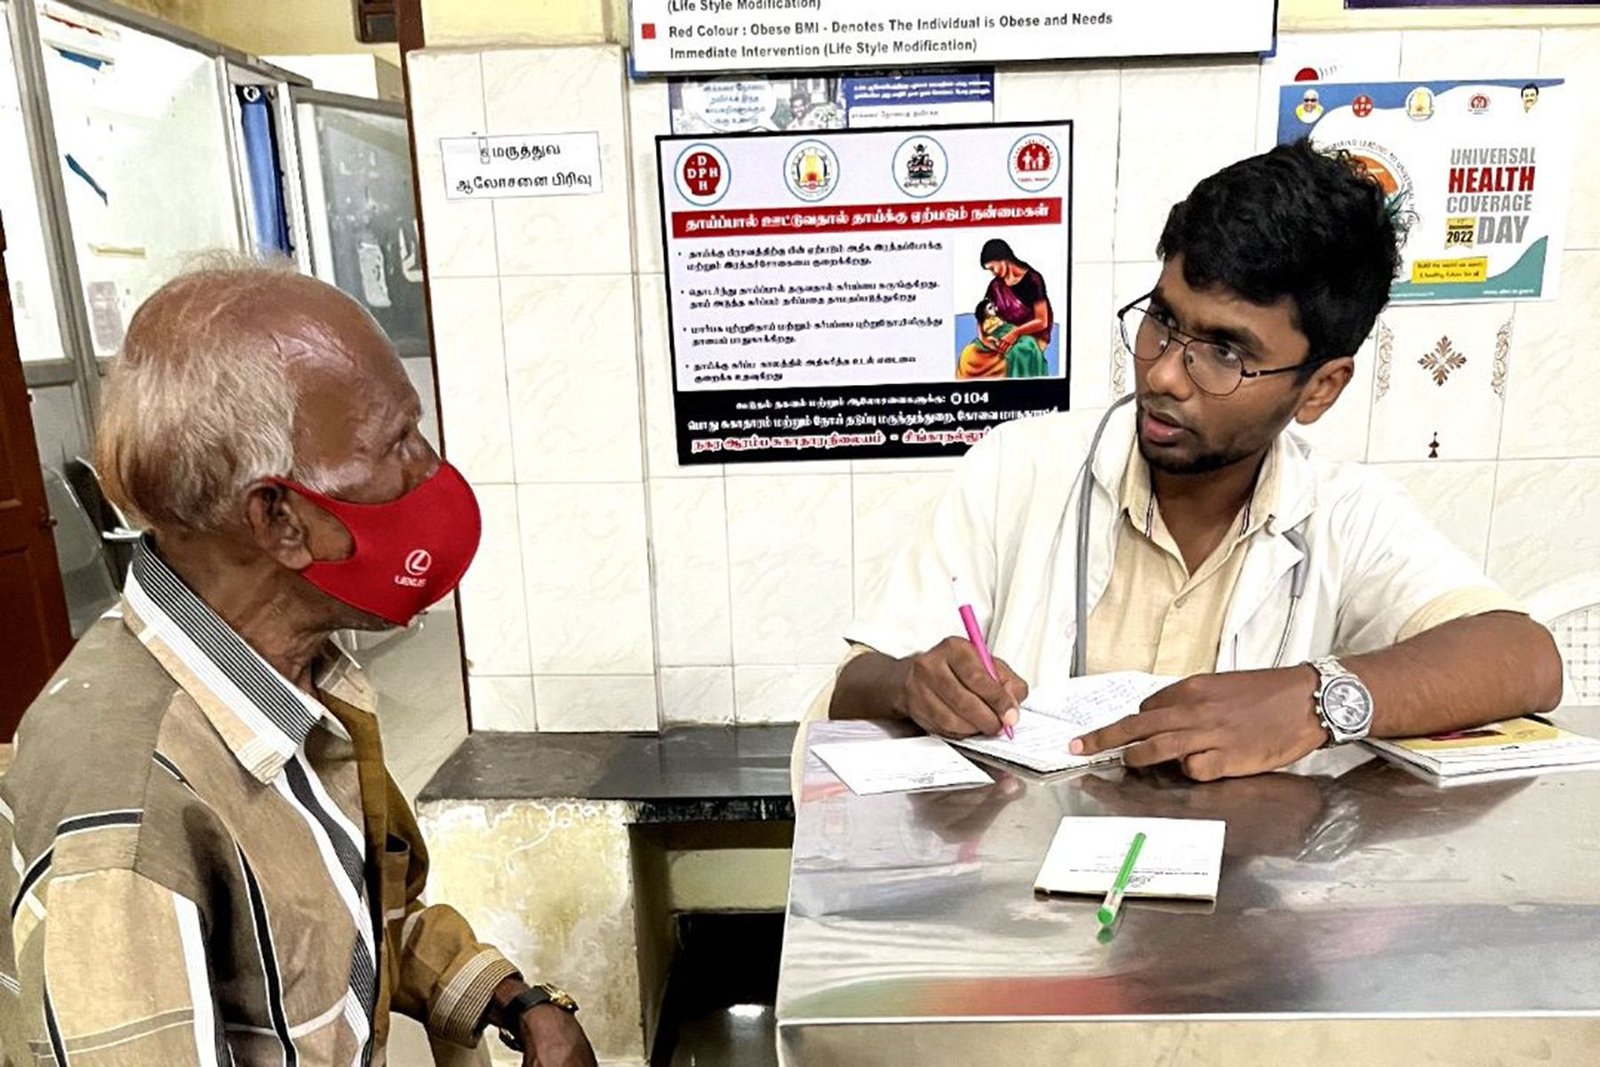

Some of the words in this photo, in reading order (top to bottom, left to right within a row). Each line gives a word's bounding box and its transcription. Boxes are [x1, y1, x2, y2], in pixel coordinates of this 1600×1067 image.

[668, 0, 696, 15] (Life
[700, 0, 733, 14] Style
[737, 0, 821, 11] Modification)
[669, 25, 693, 38] Red
[697, 24, 739, 38] Colour
[751, 23, 791, 36] Obese
[795, 21, 819, 34] BMI
[832, 20, 884, 33] Denotes
[889, 18, 913, 32] The
[917, 16, 980, 31] Individual
[984, 16, 995, 28] is
[1000, 14, 1040, 28] Obese
[1044, 13, 1068, 26] and
[1072, 12, 1113, 25] Needs
[670, 45, 737, 59] Immediate
[741, 44, 820, 58] Intervention
[824, 42, 852, 57] (Life
[856, 41, 889, 57] Style
[893, 38, 978, 53] Modification)
[492, 143, 561, 161] மருத்துவ
[1450, 146, 1536, 165] UNIVERSAL
[456, 175, 548, 194] ஆலோசனை
[552, 171, 592, 188] பிரிவு
[687, 167, 719, 179] DPH
[1448, 166, 1536, 193] HEALTH
[1446, 194, 1533, 213] COVERAGE
[685, 213, 759, 232] தாய்ப்பால்
[761, 210, 849, 228] ஊட்டுவதால்
[851, 206, 909, 226] தாய்க்கு
[911, 204, 969, 224] ஏற்படும்
[971, 202, 1050, 222] நன்மைகள்
[1446, 230, 1474, 244] 2022
[1476, 215, 1530, 245] DAY
[687, 419, 719, 432] பொது
[773, 415, 812, 430] மற்றும்
